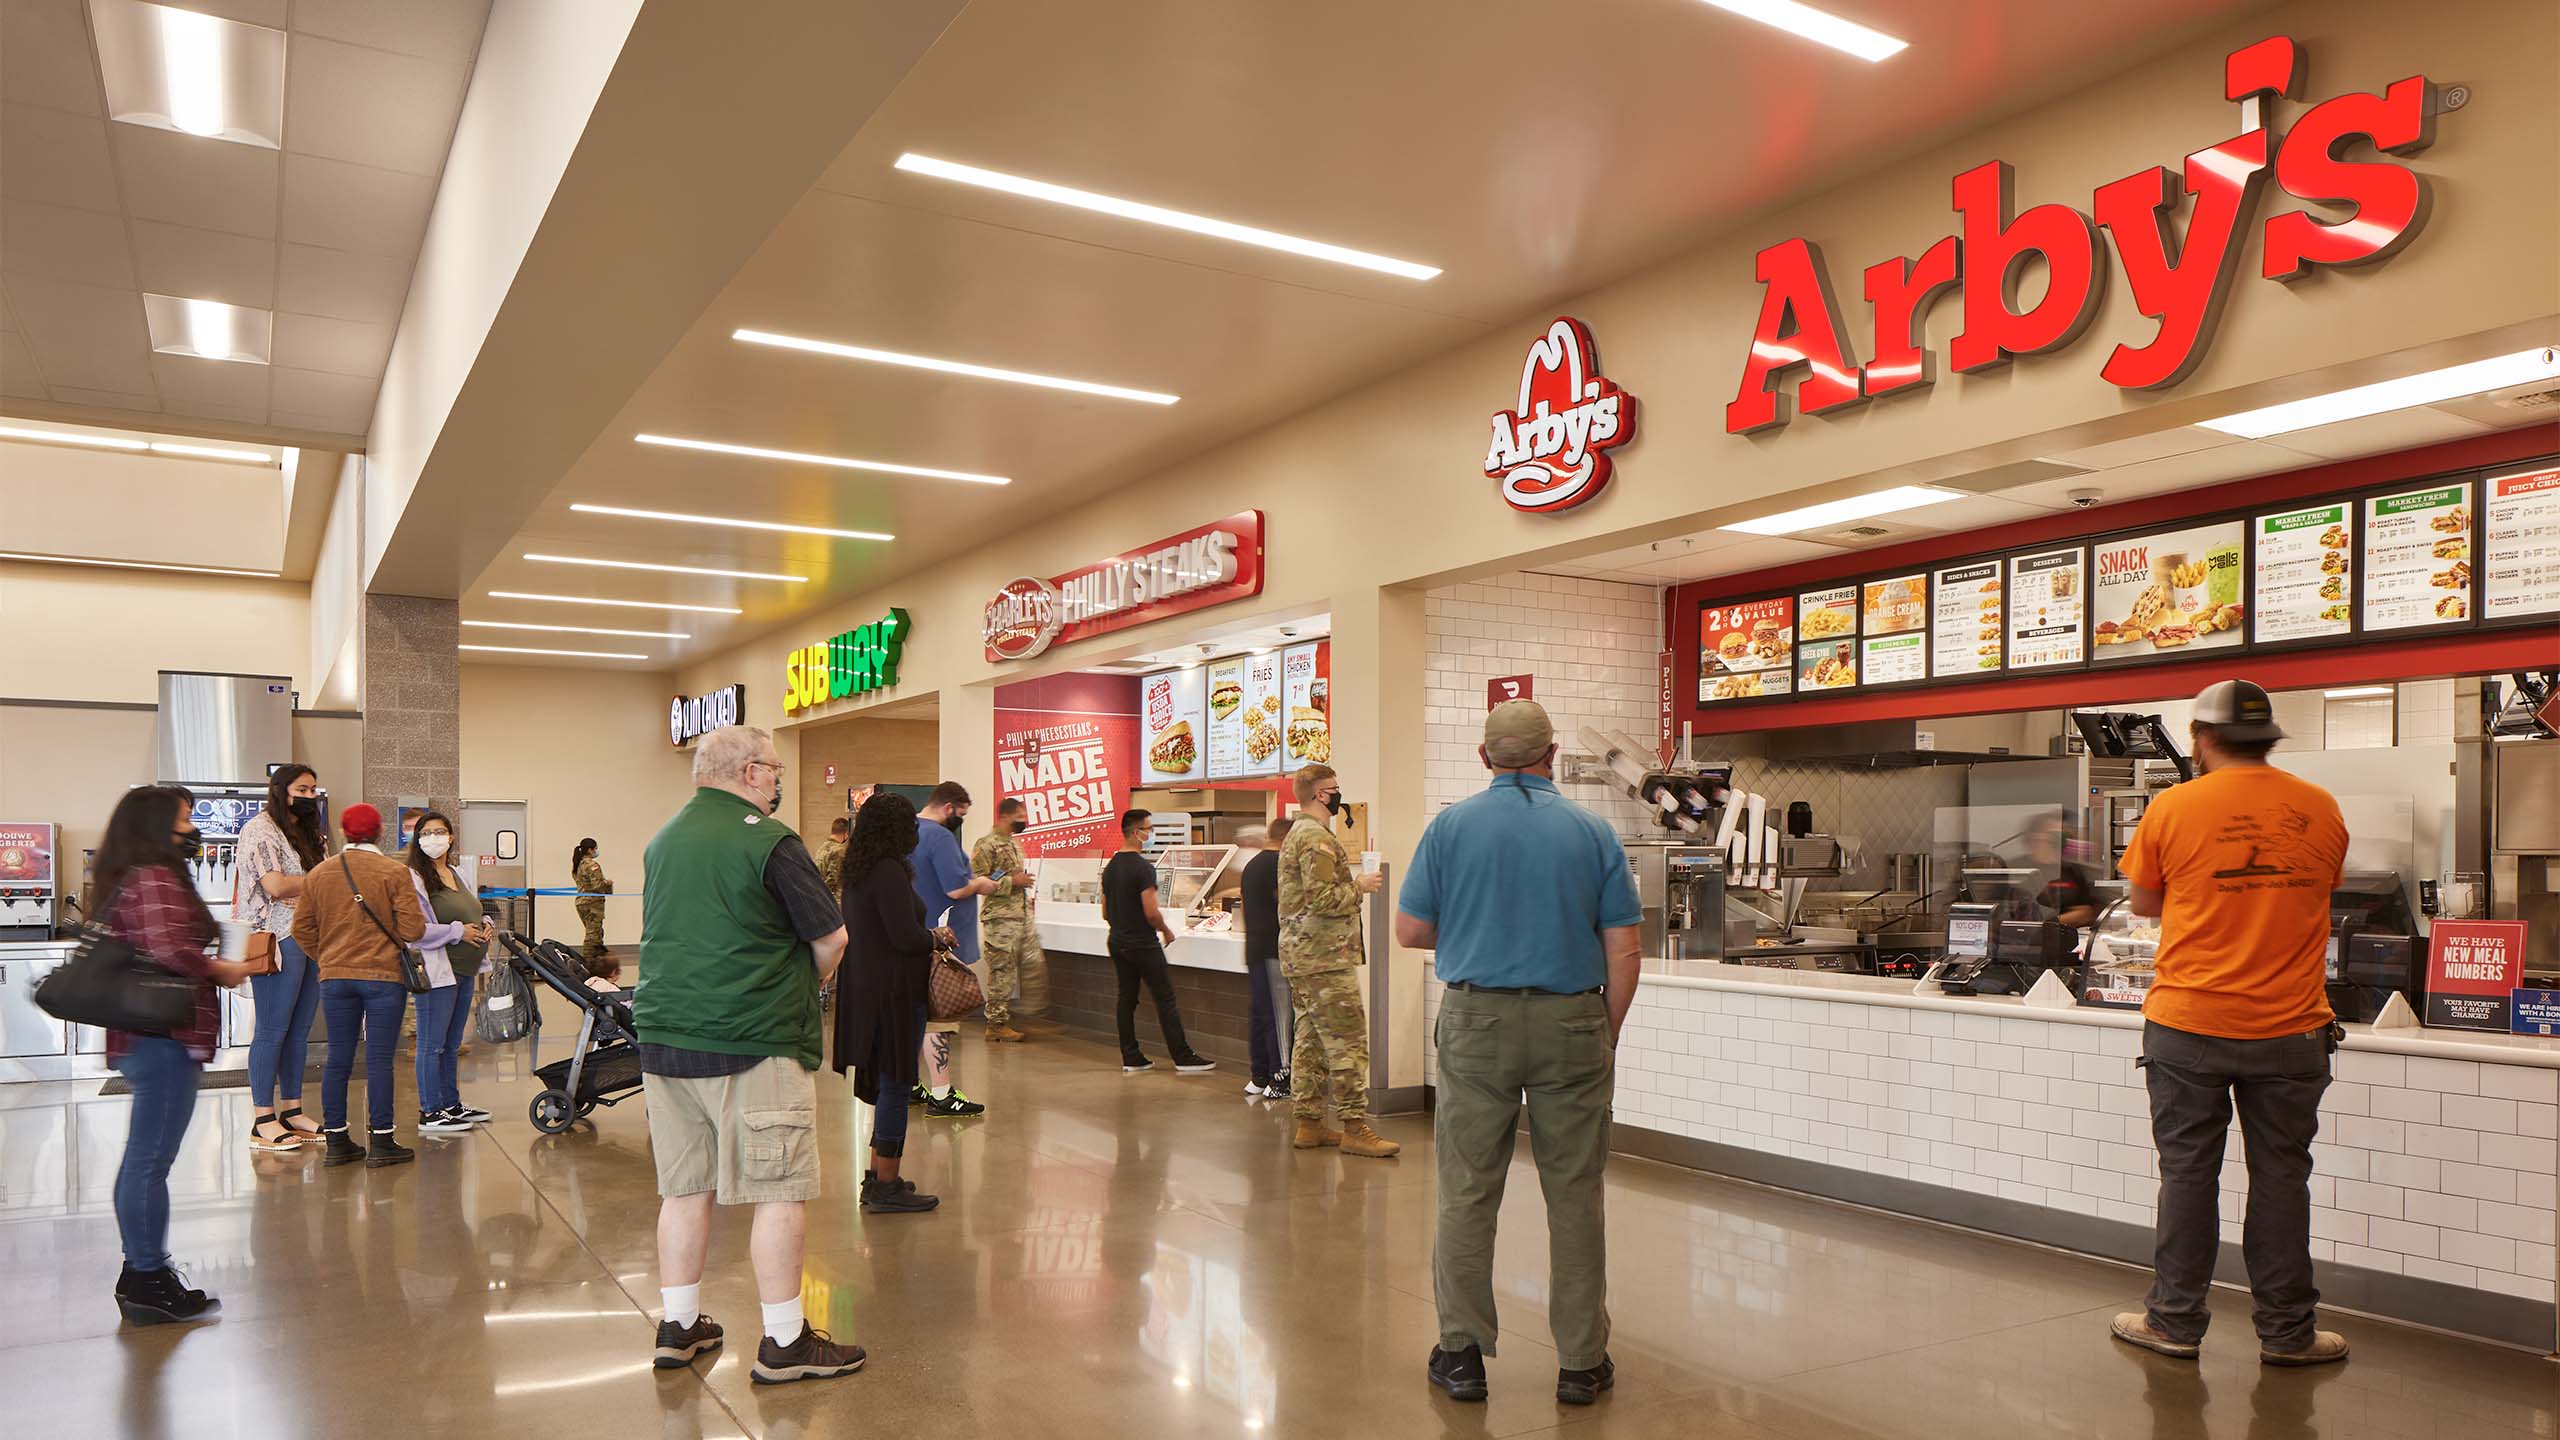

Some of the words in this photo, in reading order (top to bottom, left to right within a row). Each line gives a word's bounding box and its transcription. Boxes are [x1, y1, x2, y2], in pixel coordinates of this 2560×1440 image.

[1725, 34, 2433, 434] Arby's
[1484, 381, 1619, 472] Arby's
[2508, 482, 2536, 495] JUICY
[2387, 496, 2424, 508] MARKET
[2424, 491, 2449, 502] FRESH
[2275, 515, 2306, 526] MARKET
[2306, 511, 2331, 520] FRESH
[2033, 558, 2062, 567] DESSERTS
[2100, 546, 2149, 575] SNACK
[1062, 562, 1130, 624] PHILLY
[1132, 530, 1238, 602] STEAKS
[1947, 573, 1963, 581] SIDES
[1968, 569, 1991, 577] SNACKS
[2099, 574, 2121, 587] ALL
[2124, 570, 2149, 583] DAY
[1802, 593, 1833, 605] CRINKLE
[1834, 590, 1856, 600] FRIES
[1744, 600, 1785, 612] EVERYDAY
[1896, 601, 1921, 616] CREAM
[982, 590, 1053, 641] CHARLEYS
[1709, 610, 1721, 631] 2
[1744, 607, 1785, 621] VALUE
[2028, 627, 2065, 637] BEVERAGES
[783, 607, 906, 717] SUBWAY
[1287, 661, 1311, 675] CHICKEN
[1252, 667, 1273, 683] FRIES
[1762, 676, 1790, 685] NUGGETS
[1662, 666, 1671, 713] PICK
[683, 697, 700, 738] SLIM
[702, 685, 737, 734] CHICKENS
[1663, 717, 1671, 740] UP
[999, 745, 1108, 793] MADE
[1041, 838, 1067, 852] since
[1068, 833, 1091, 848] 1986
[2449, 936, 2469, 946] WE
[2471, 937, 2505, 948] HAVE
[2443, 946, 2471, 963] NEW
[2474, 947, 2508, 965] MEAL
[2445, 962, 2504, 981] NUMBERS
[2107, 992, 2143, 1002] SWEETS
[2443, 998, 2463, 1007] YOUR
[2463, 1000, 2501, 1009] FAVORITE
[2451, 1011, 2489, 1020] CHANGED
[2469, 1006, 2491, 1014] HAVE
[2519, 1009, 2538, 1017] WITH
[2539, 1010, 2546, 1018] A
